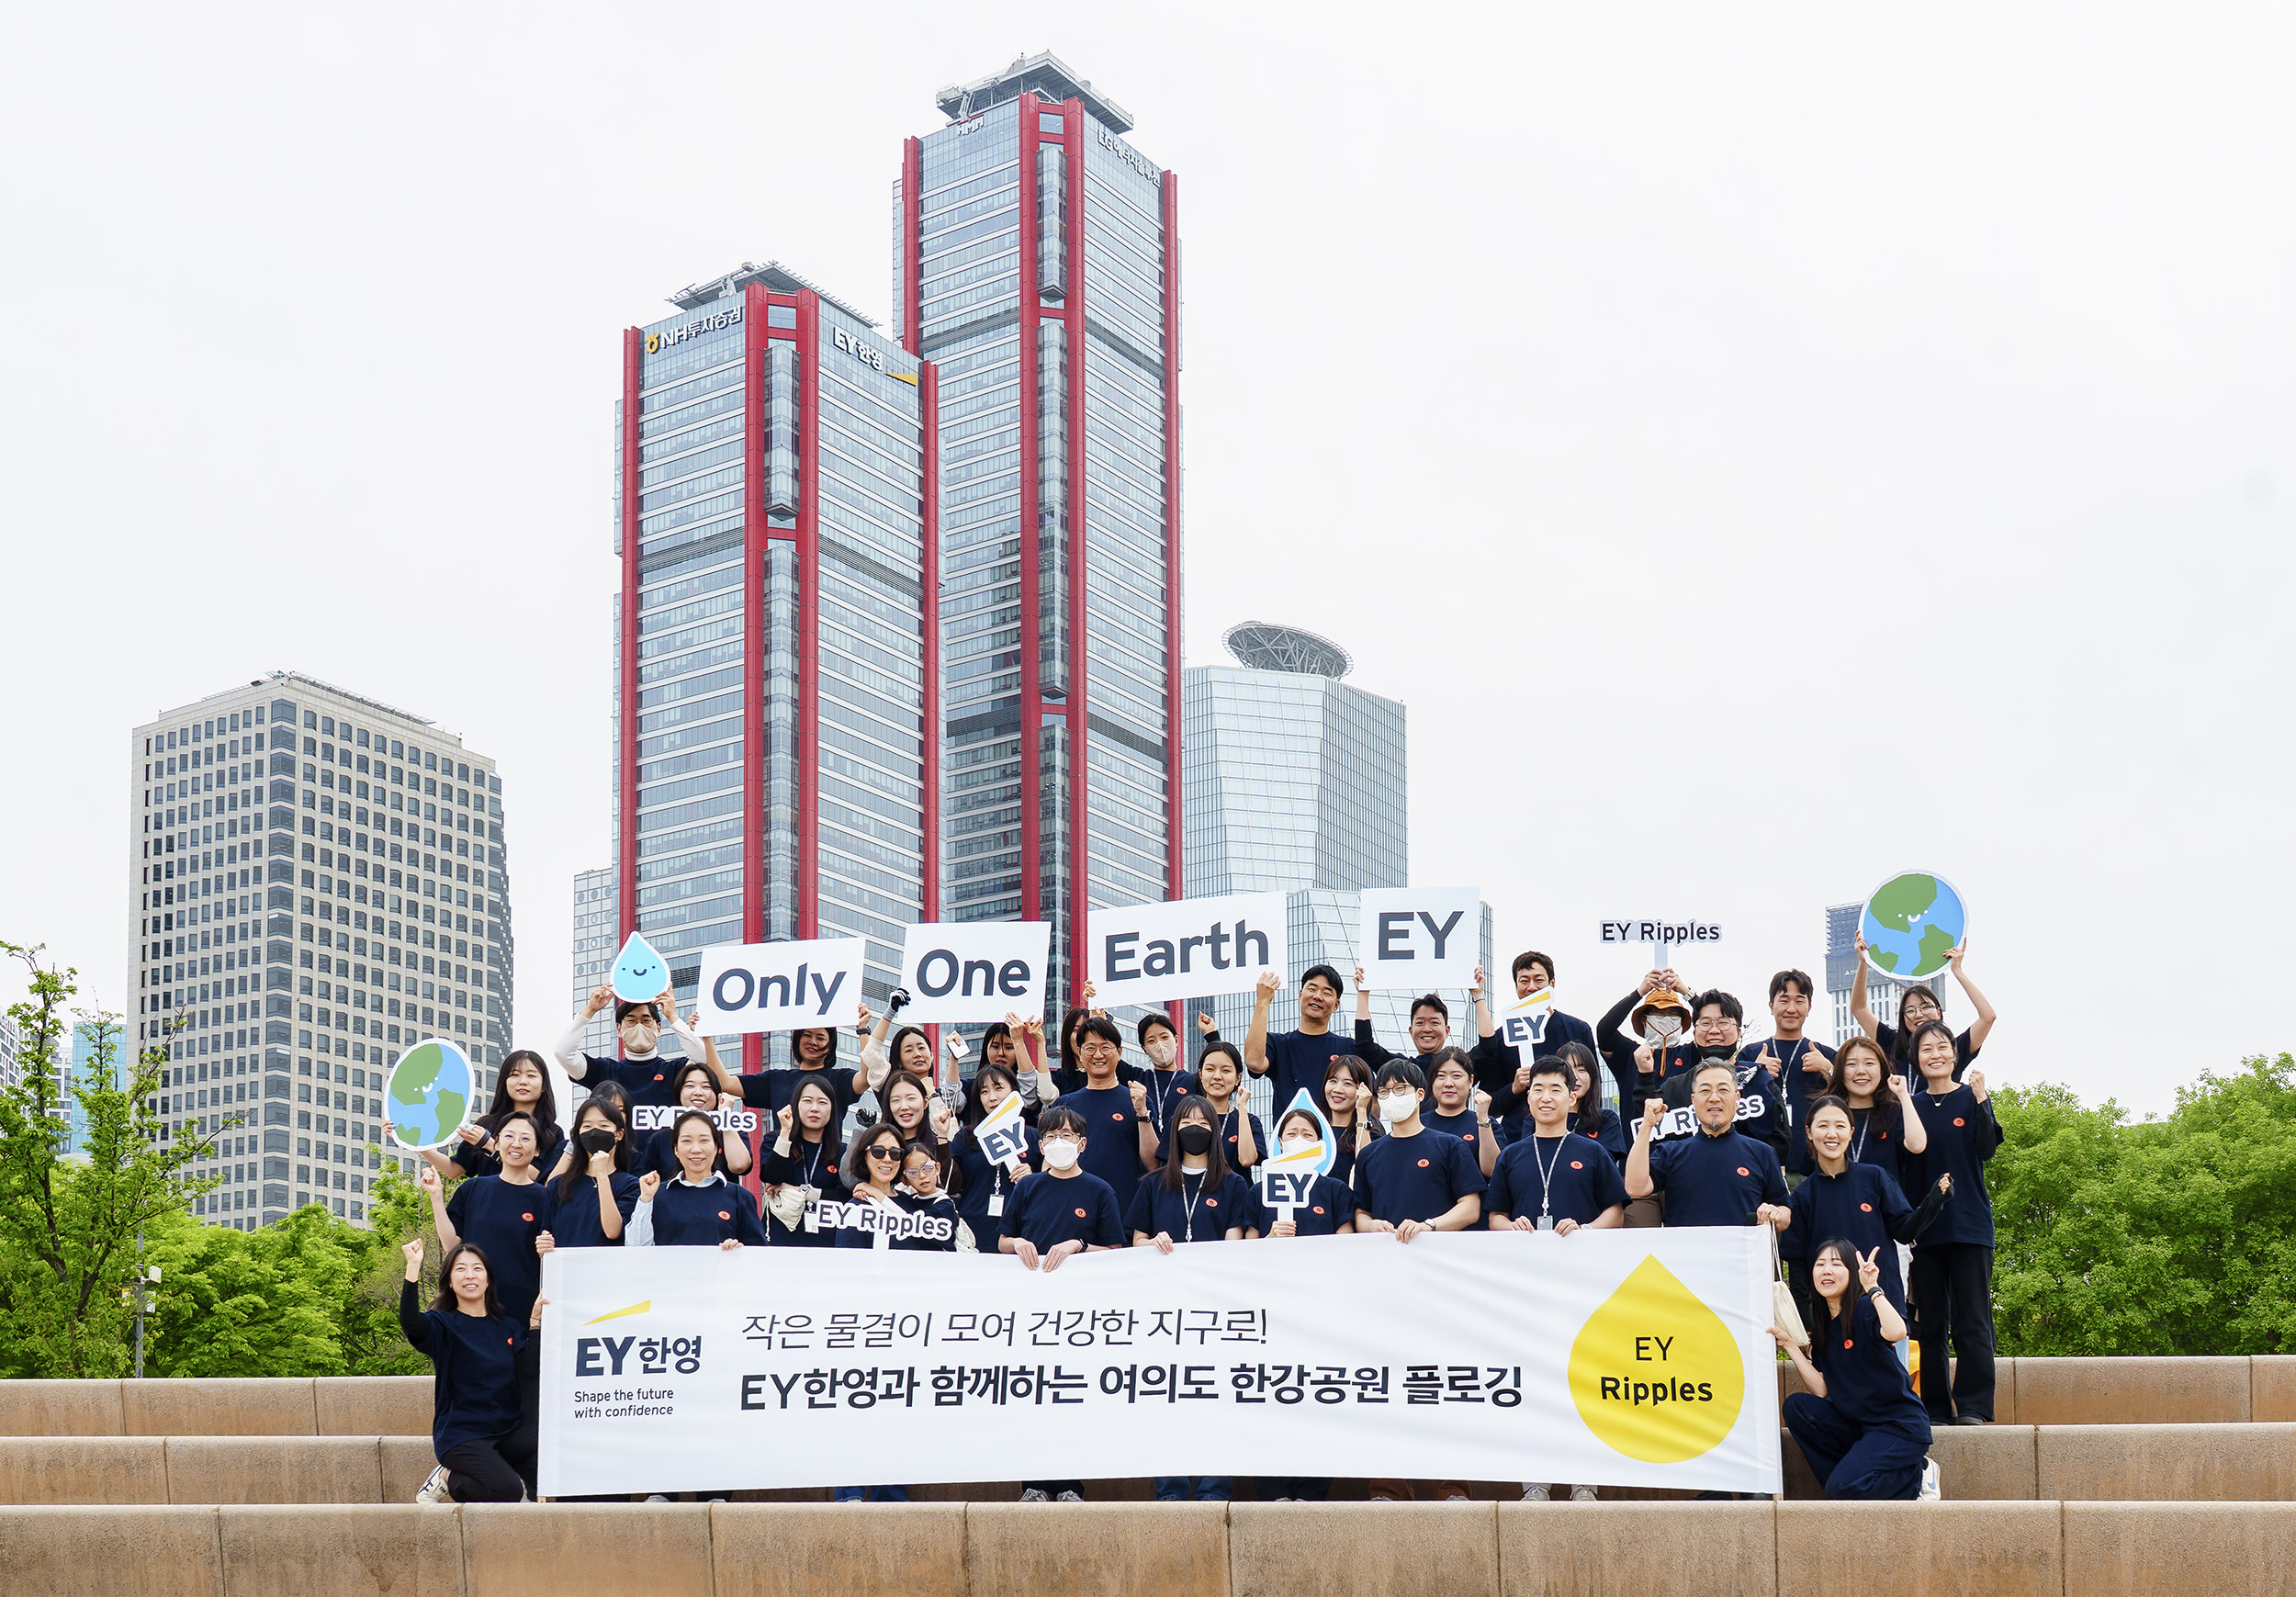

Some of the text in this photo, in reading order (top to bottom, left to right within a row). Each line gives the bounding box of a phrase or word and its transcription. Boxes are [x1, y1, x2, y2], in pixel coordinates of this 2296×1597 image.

[660, 306, 742, 349] NH투자증권
[1379, 910, 1465, 961] EY
[1602, 921, 1720, 945] EY Ripples
[1106, 919, 1269, 982] Earth
[713, 962, 847, 1016] Only
[917, 949, 1030, 997] One
[1506, 1015, 1546, 1042] EY
[636, 1108, 665, 1127] EY
[1674, 1098, 1761, 1131] Ries
[983, 1121, 1023, 1161] EY
[1267, 1173, 1313, 1202] EY
[819, 1204, 949, 1237] EY Ripples
[741, 1309, 1267, 1350] 작은 물결이 모여 건강한 지구로!
[1635, 1336, 1674, 1361] EY
[574, 1388, 674, 1403] Shape the future
[740, 1363, 1523, 1411] EY한영과 함께하는 여의도 한강공원 플로깅
[1601, 1376, 1713, 1407] Ripples
[574, 1403, 674, 1419] with confidence
